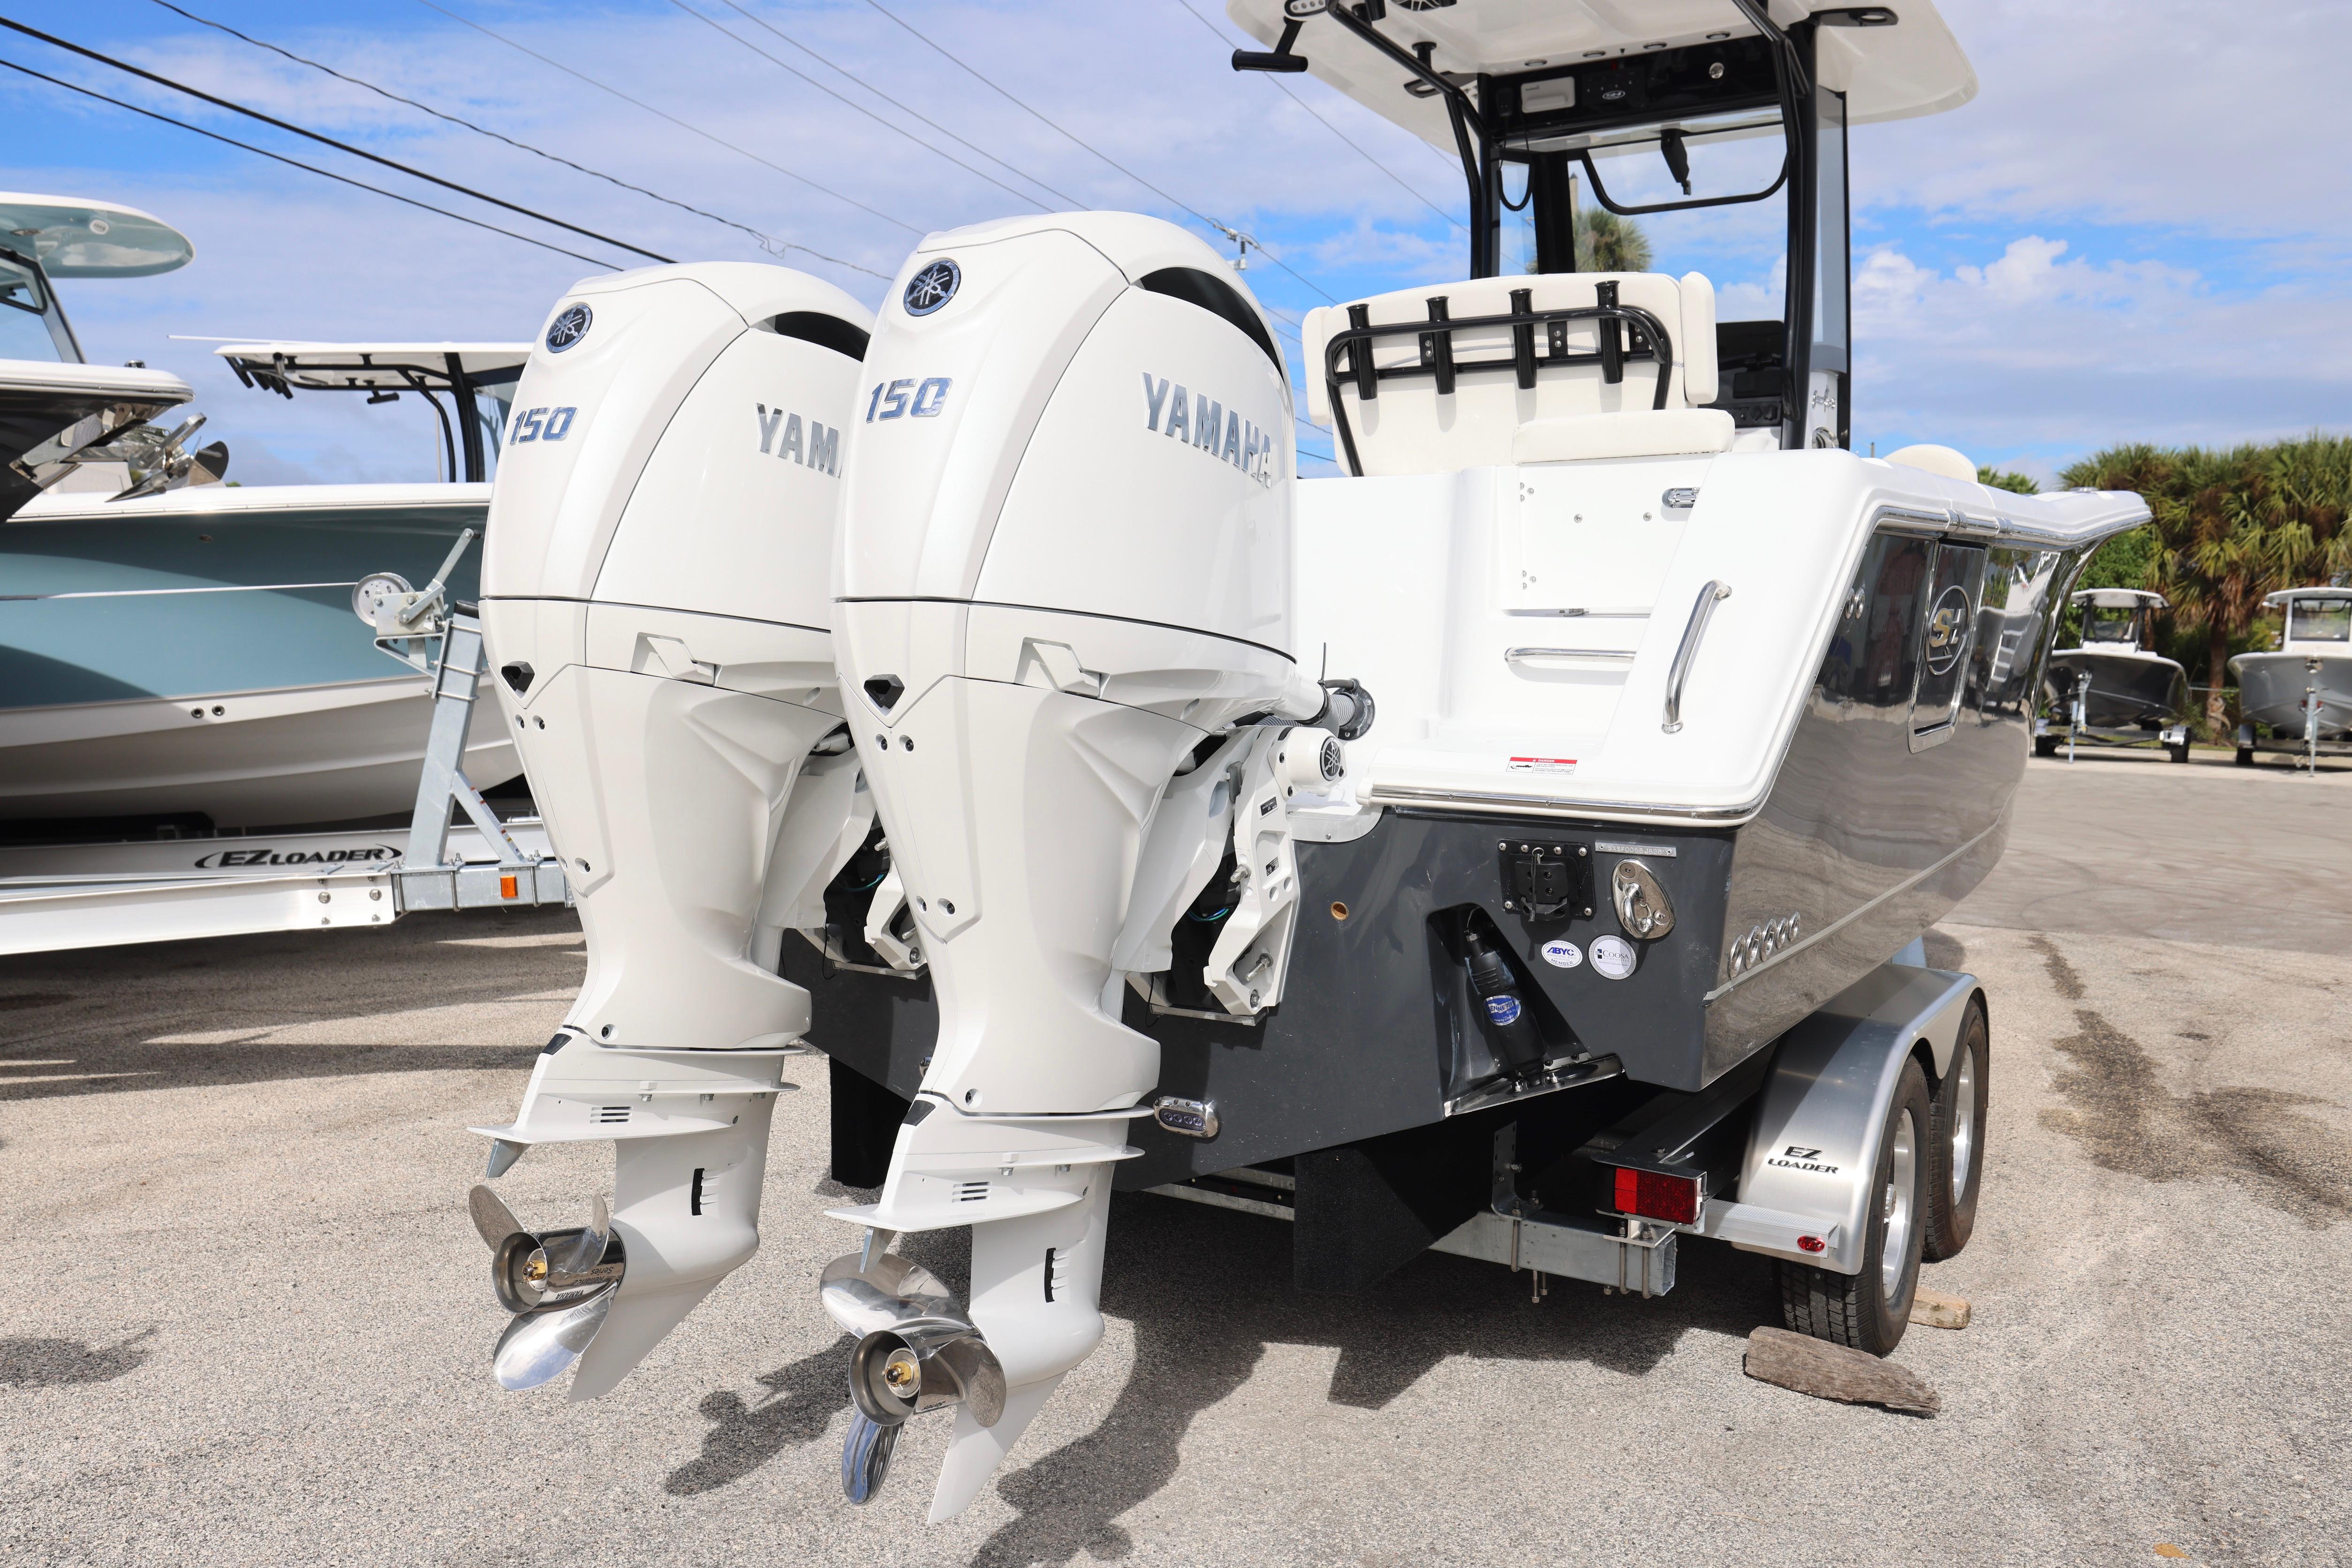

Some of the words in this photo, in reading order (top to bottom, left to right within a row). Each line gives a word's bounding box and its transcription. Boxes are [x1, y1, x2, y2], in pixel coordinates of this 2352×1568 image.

[866, 377, 953, 424] 150
[510, 407, 579, 446] 150
[1141, 371, 1271, 488] YAMAHA
[755, 402, 844, 480] YAM
[1547, 947, 1574, 956] ABYC
[1489, 1002, 1513, 1012] ENNETT
[1784, 1146, 1823, 1161] EZ
[1768, 1158, 1839, 1174] LOADER
[590, 1267, 614, 1276] Series
[573, 1276, 605, 1286] Reliance
[555, 1290, 584, 1300] YAMAHA
